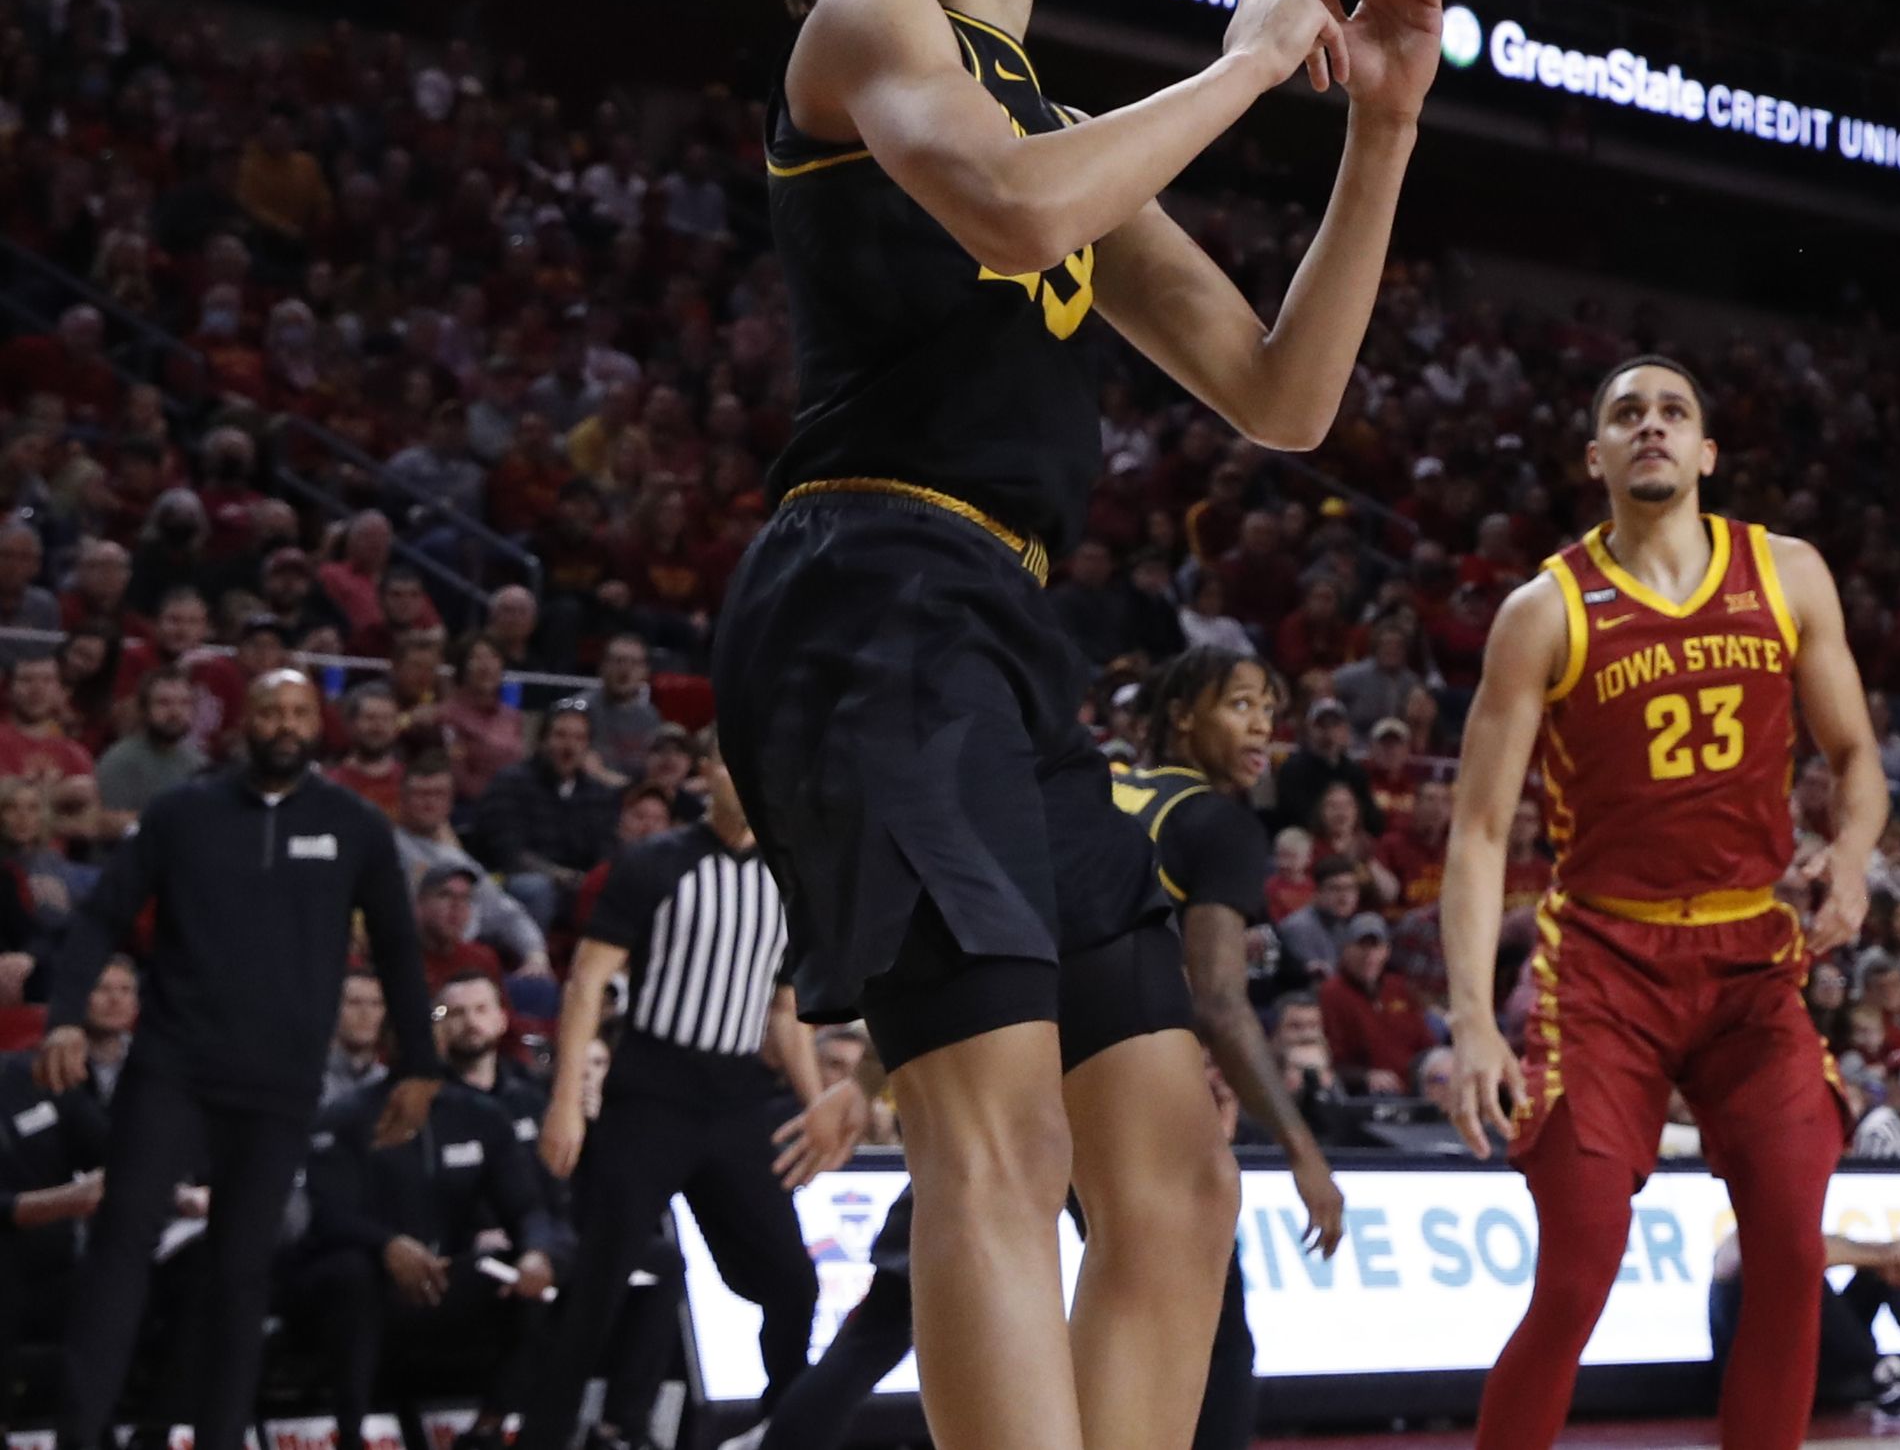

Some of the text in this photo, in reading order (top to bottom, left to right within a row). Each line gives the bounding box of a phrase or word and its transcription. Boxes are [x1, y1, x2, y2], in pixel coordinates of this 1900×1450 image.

[1490, 20, 1705, 121] GreenState
[1707, 83, 1833, 150] CREDIT
[1595, 634, 1783, 704] IOWA STATE
[1644, 683, 1744, 780] 23
